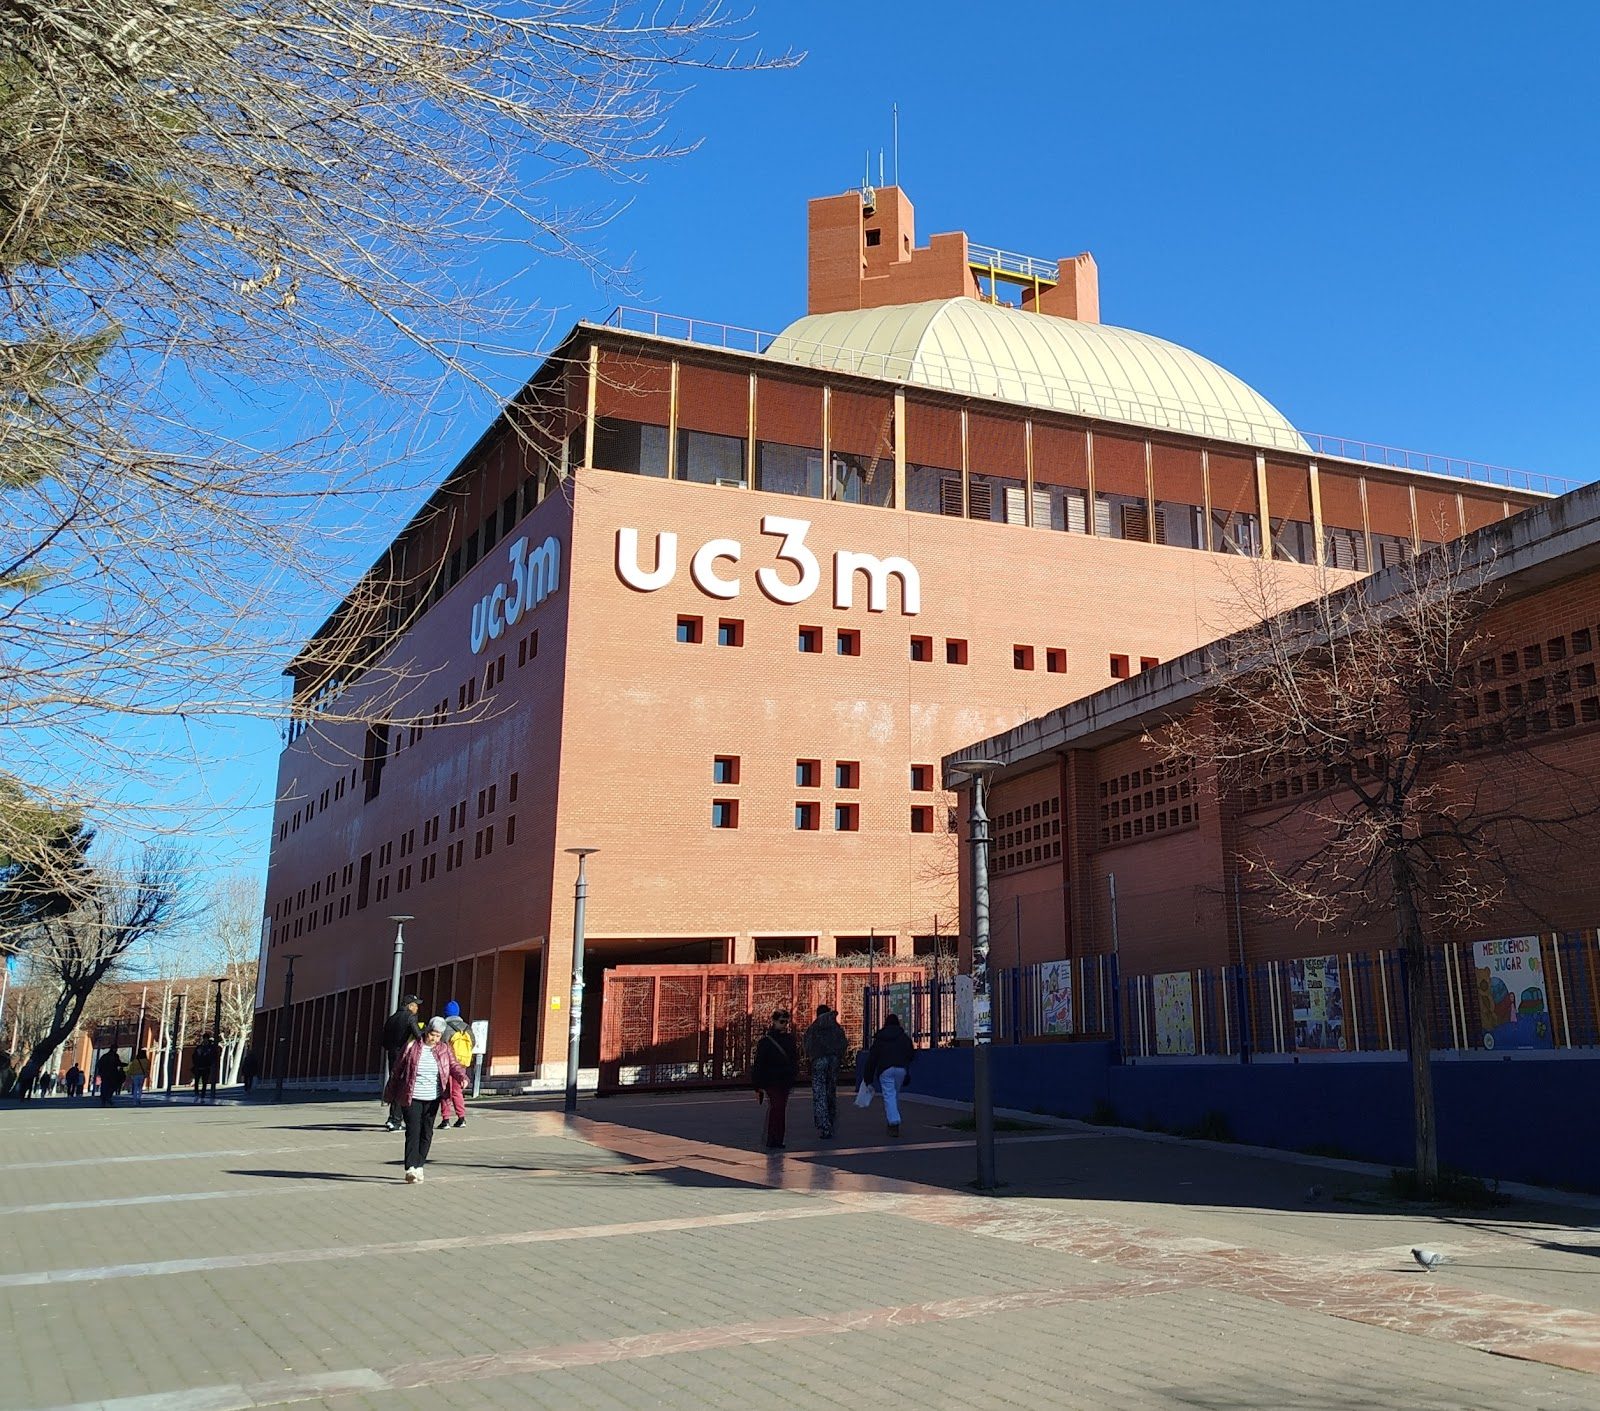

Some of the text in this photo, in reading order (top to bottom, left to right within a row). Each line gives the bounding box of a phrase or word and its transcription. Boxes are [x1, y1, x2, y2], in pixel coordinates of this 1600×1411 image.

[615, 515, 921, 616] uc3m
[471, 536, 561, 655] uc3m
[1482, 939, 1530, 956] MERECEMOS
[1494, 956, 1522, 972] JUGAR
